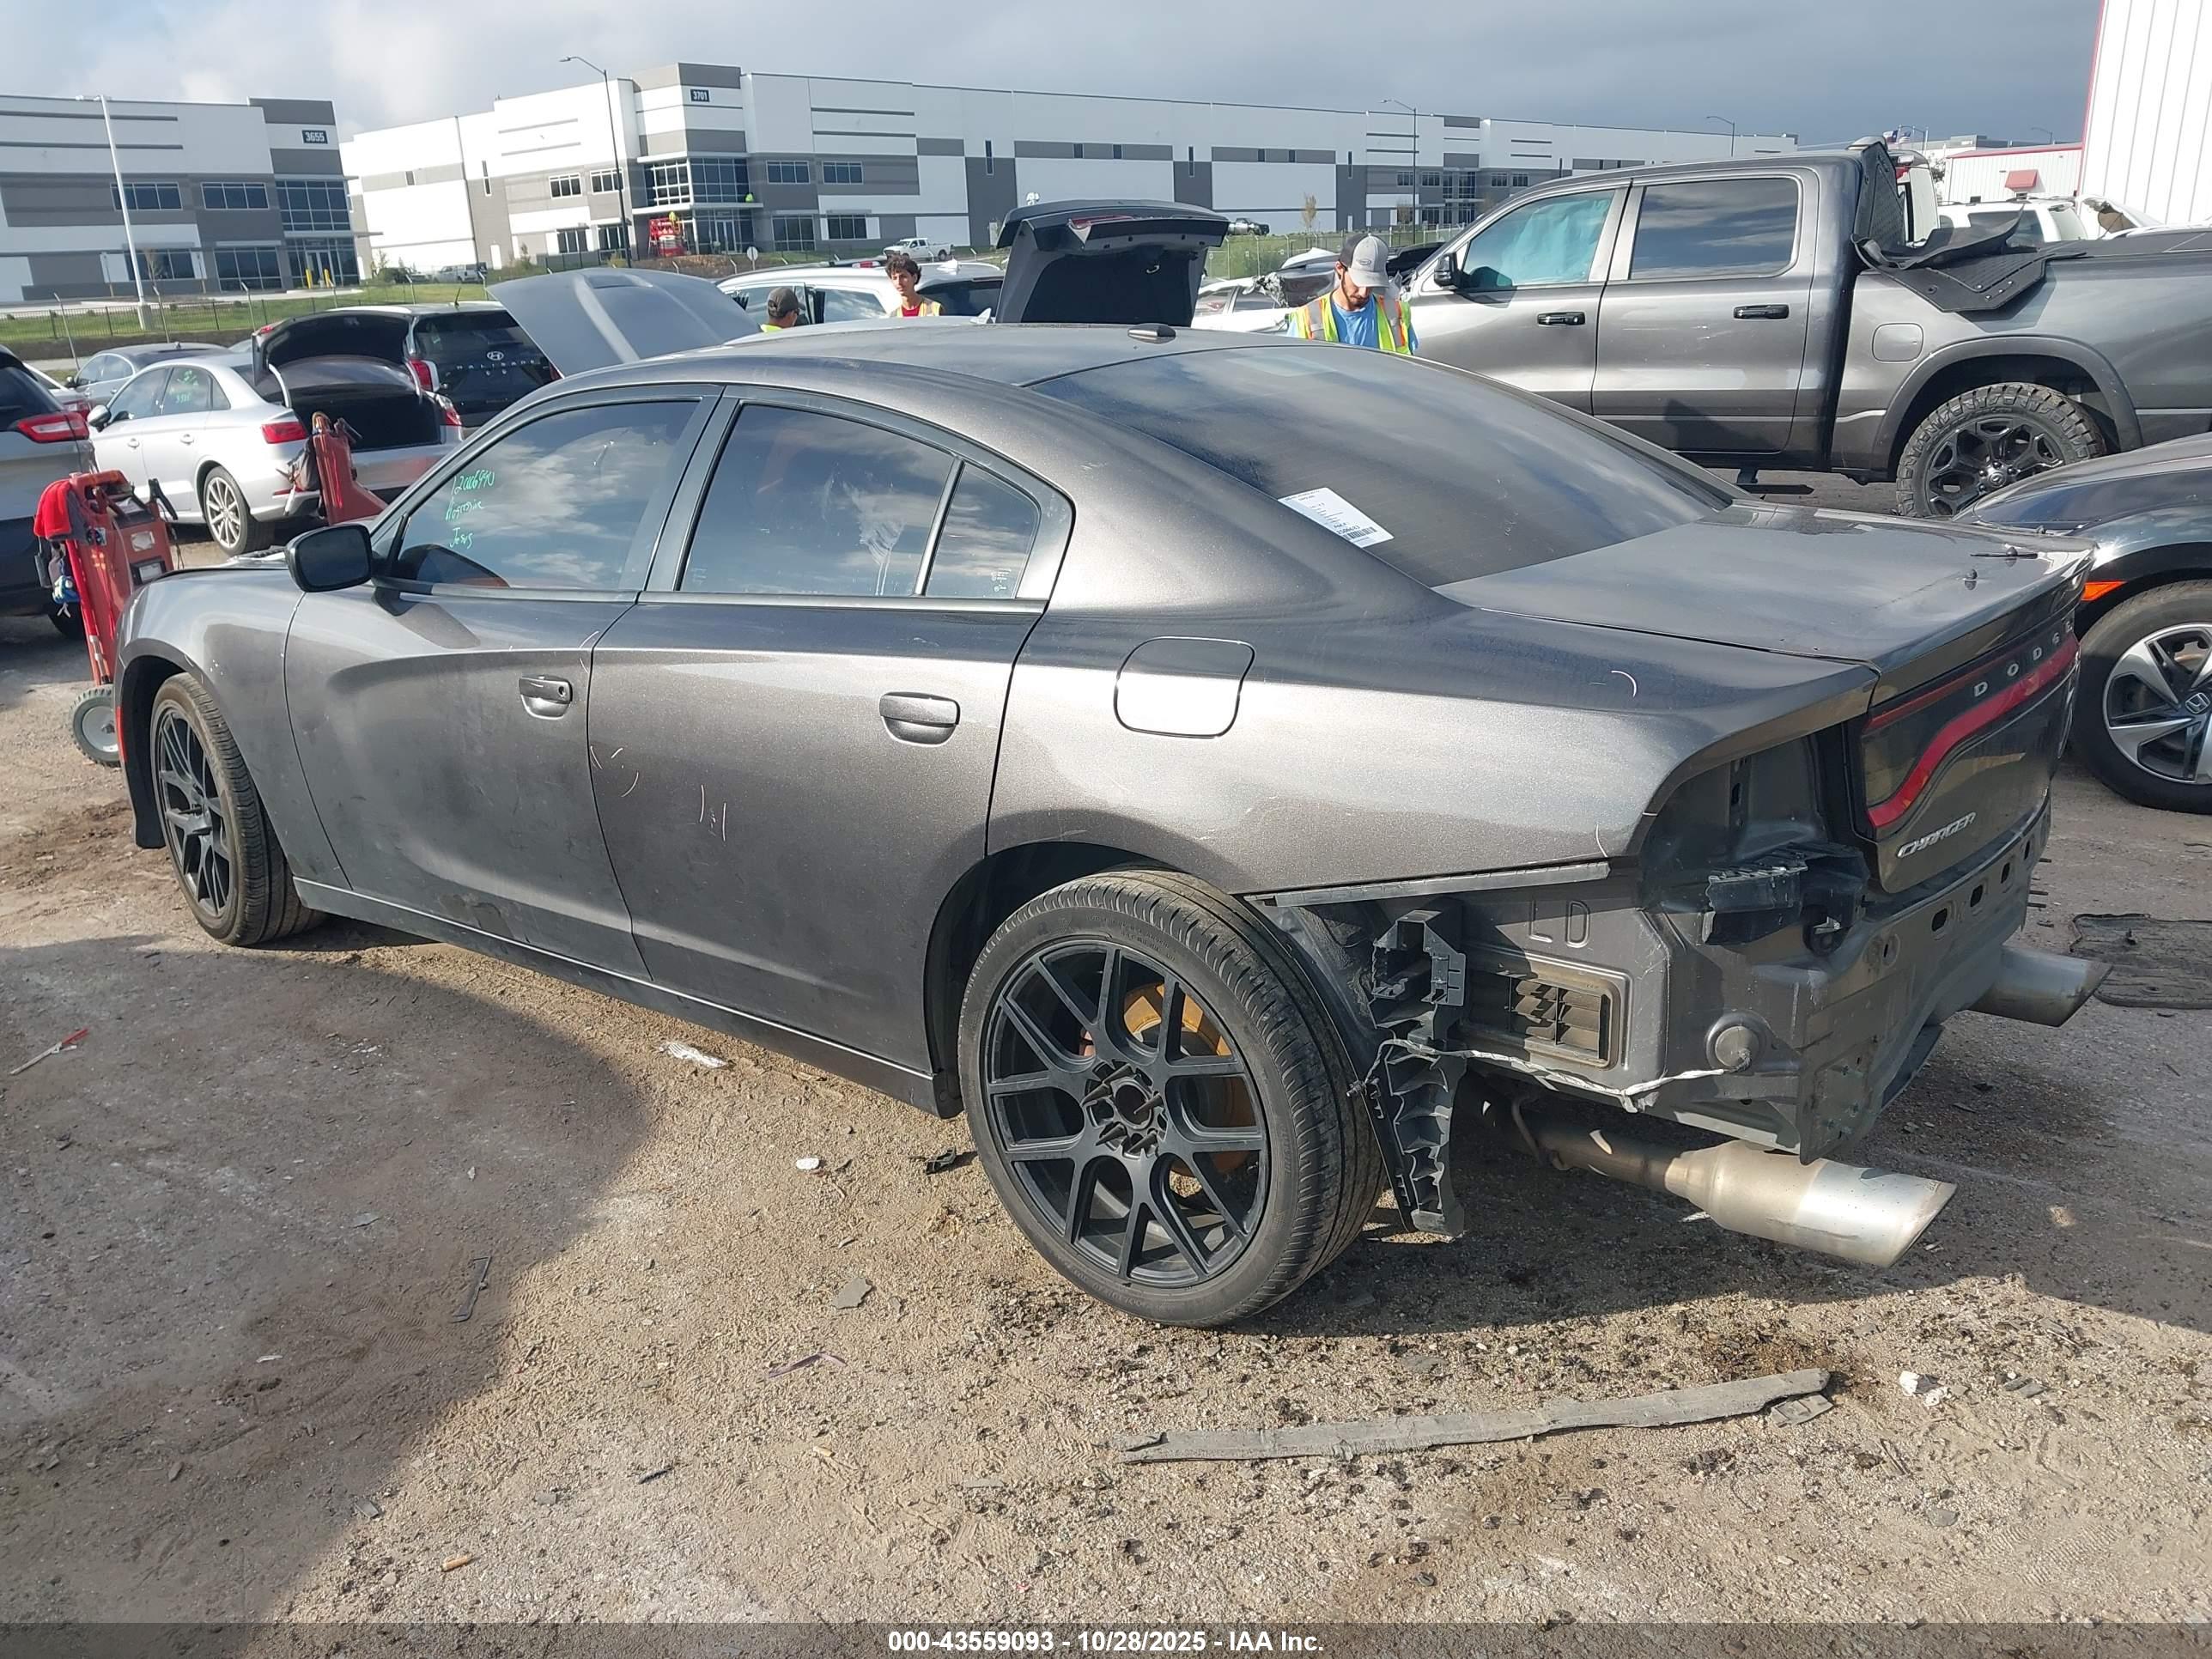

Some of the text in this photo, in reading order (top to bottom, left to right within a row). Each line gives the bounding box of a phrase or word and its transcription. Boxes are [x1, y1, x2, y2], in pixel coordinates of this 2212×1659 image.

[693, 90, 708, 100] 3701
[305, 131, 325, 142] 3655
[1897, 811, 1977, 859] CHARGER
